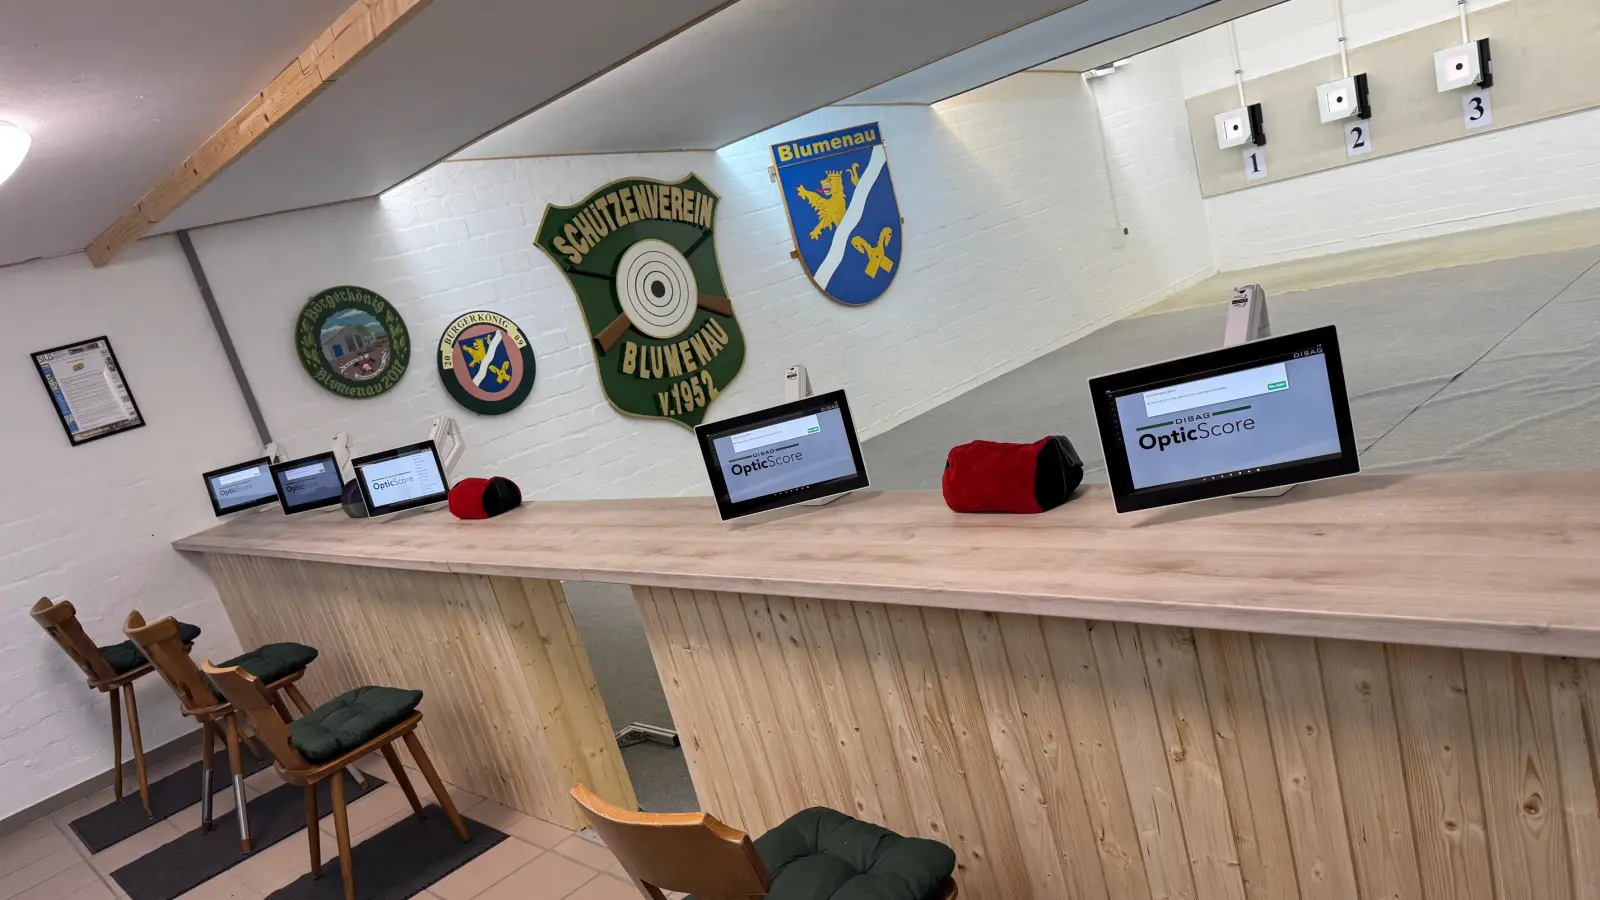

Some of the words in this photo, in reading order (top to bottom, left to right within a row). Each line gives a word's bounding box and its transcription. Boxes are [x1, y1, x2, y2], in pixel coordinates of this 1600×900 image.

[1469, 97, 1485, 121] 3
[777, 129, 876, 162] Blumenau
[1350, 126, 1365, 149] 2
[1248, 153, 1260, 174] 1
[553, 184, 714, 264] SCHÜTZENVEREIN
[622, 317, 729, 379] BLUMENAU
[1293, 347, 1323, 359] DISAG
[315, 366, 382, 397] Blumenau
[1174, 411, 1211, 425] DISAG
[1138, 417, 1256, 451] OpticScore
[731, 452, 803, 476] OpticScore
[373, 476, 414, 490] OpticScore
